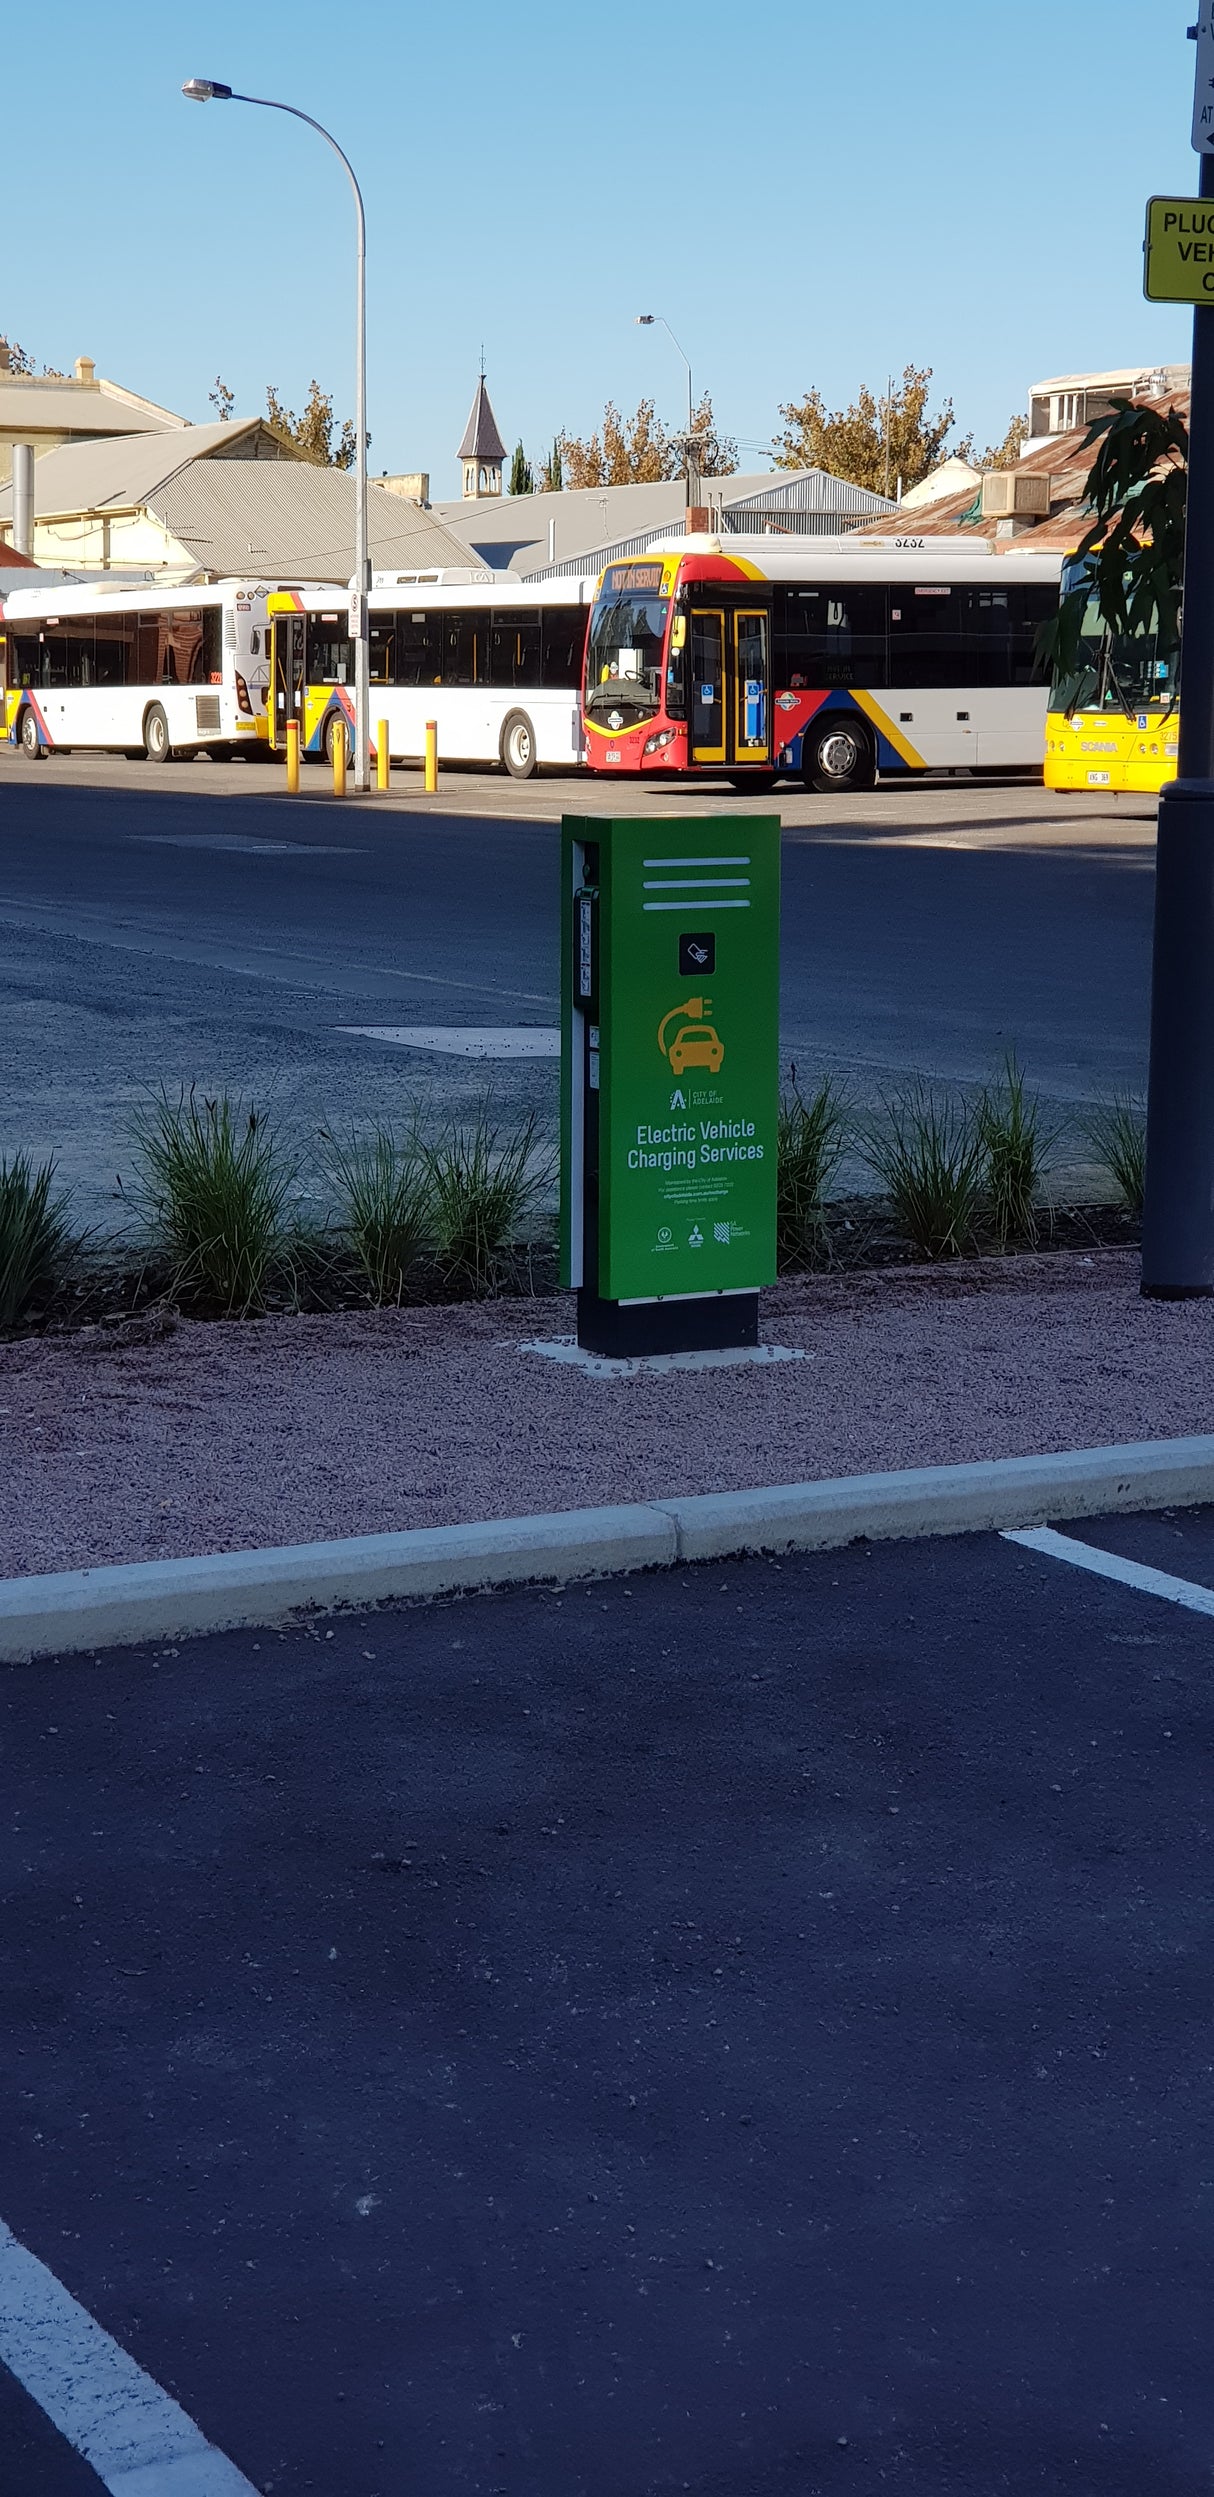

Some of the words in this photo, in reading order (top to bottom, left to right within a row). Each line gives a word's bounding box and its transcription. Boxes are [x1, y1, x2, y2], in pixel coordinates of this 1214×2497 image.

[1200, 105, 1214, 124] AT
[1080, 741, 1118, 753] SCANIA
[692, 1090, 707, 1098] CITY
[692, 1096, 724, 1105] ADELAIDE
[637, 1122, 696, 1145] Electric
[700, 1119, 755, 1140] Vehicle
[627, 1146, 696, 1171] Charging
[700, 1142, 764, 1163] Services
